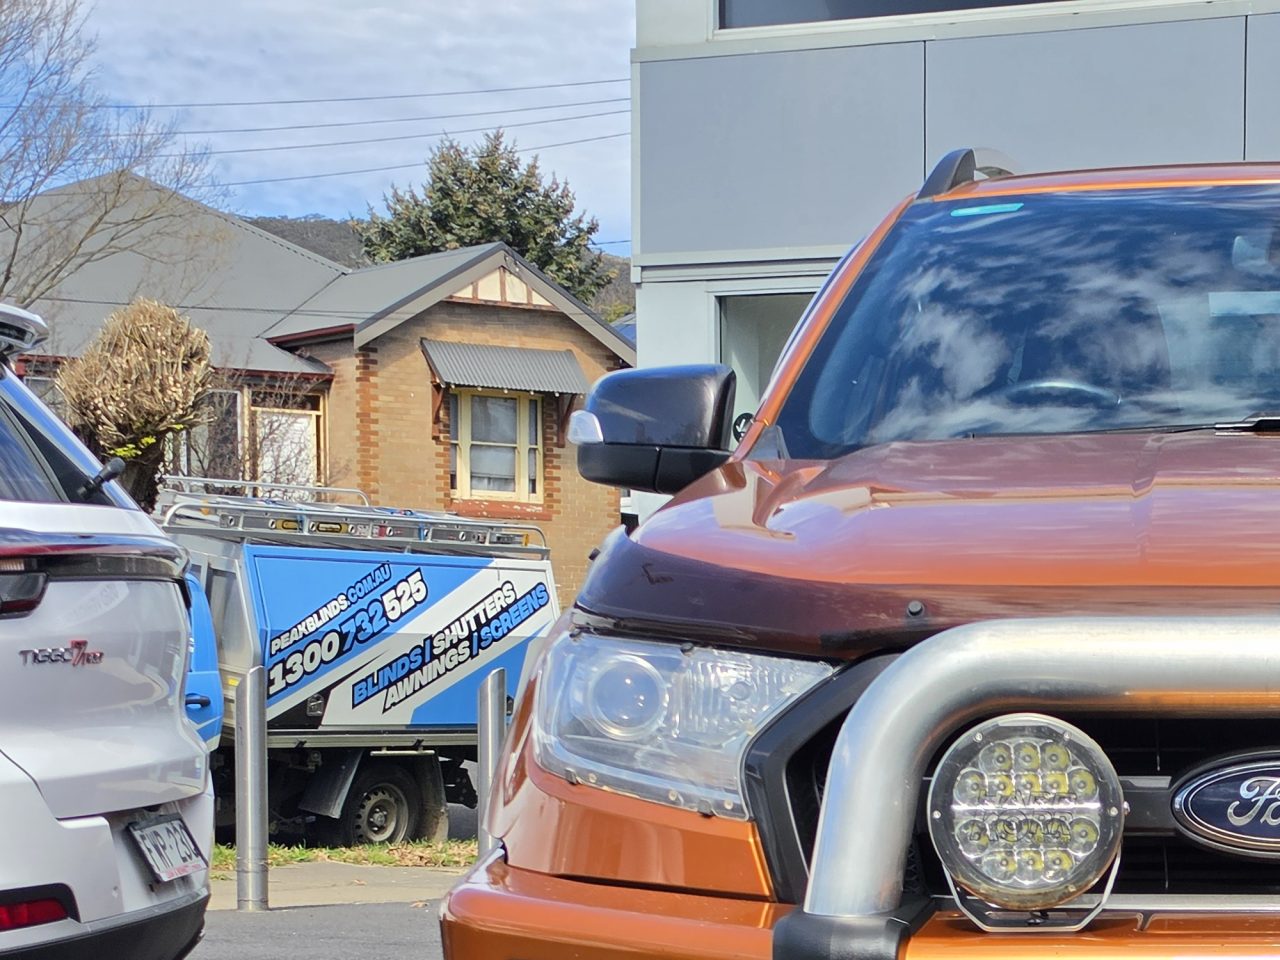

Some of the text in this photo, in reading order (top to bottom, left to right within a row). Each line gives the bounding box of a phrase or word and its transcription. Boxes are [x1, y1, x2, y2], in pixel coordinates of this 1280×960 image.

[268, 570, 429, 696] 1300 732 525
[270, 562, 393, 656] PEAKBLINDS.COM.AU
[352, 647, 423, 706] BLINDS
[432, 583, 517, 655] SHUTTERS
[383, 640, 471, 711] AWNINGS
[480, 584, 550, 649] SCREENS
